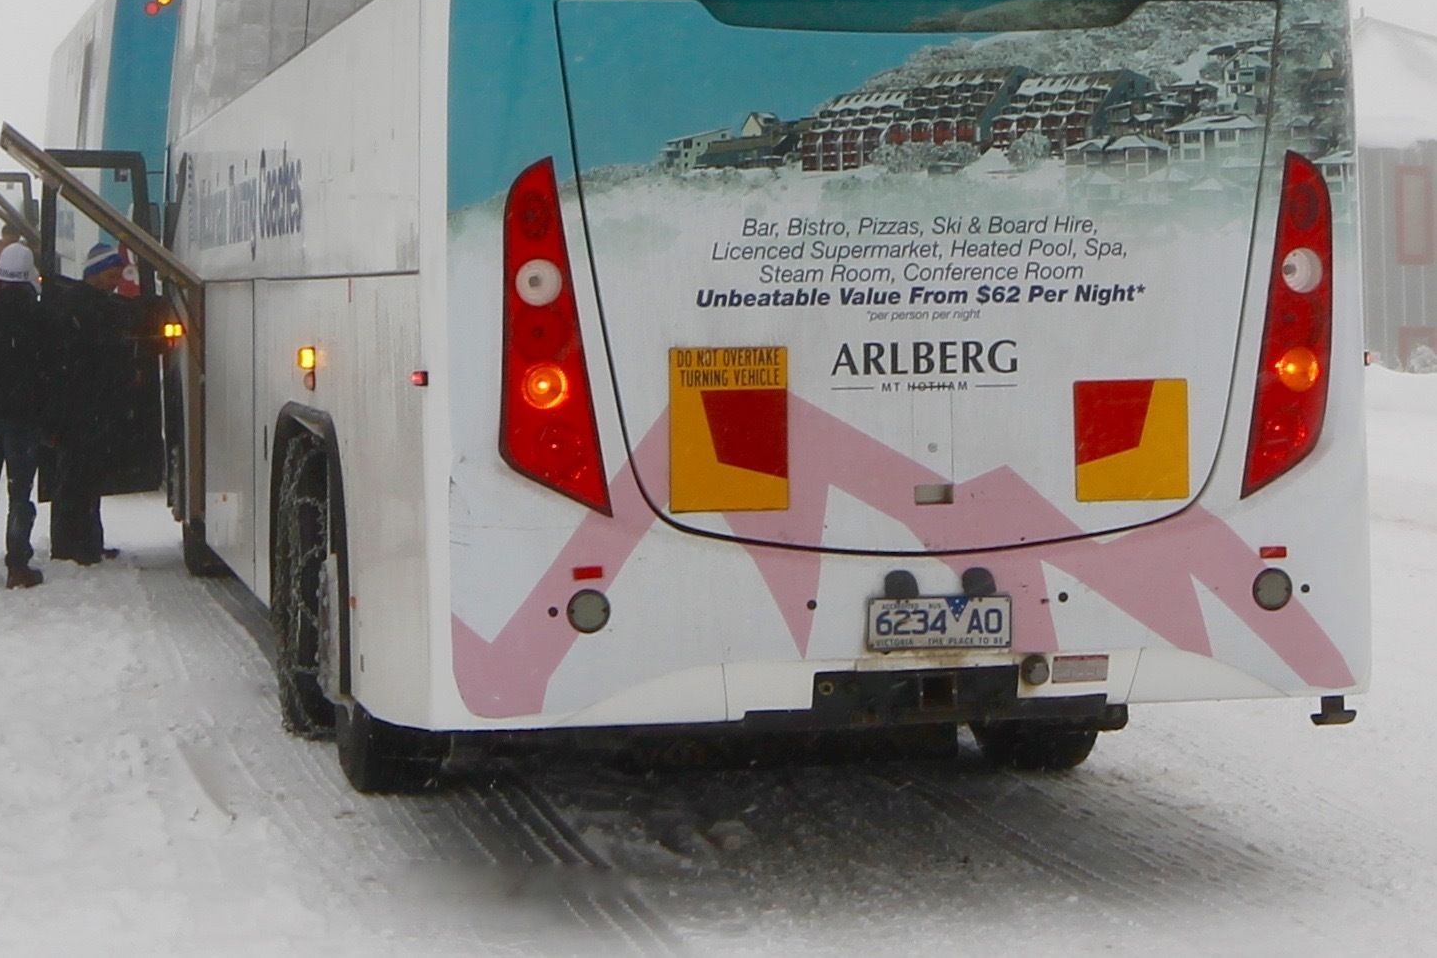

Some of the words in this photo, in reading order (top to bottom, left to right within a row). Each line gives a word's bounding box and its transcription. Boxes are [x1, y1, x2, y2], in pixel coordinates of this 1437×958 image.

[742, 218, 779, 238] Bar,
[787, 218, 850, 238] Bistro,
[858, 217, 924, 237] Pizzas,
[931, 216, 963, 235] Ski
[968, 216, 981, 234] &
[988, 216, 1049, 235] Board
[1054, 216, 1098, 236] Hire,
[712, 242, 805, 261] Licenced
[810, 240, 943, 262] Supermarket,
[950, 239, 1022, 258] Heated
[1028, 239, 1076, 259] Pool,
[1084, 238, 1127, 260] Spa,
[759, 264, 823, 283] Steam
[830, 264, 895, 284] Room,
[904, 262, 1019, 282] Conference
[1024, 261, 1084, 281] Room
[696, 289, 831, 308] Unbeatable
[839, 287, 901, 306] Value
[909, 286, 968, 304] From
[976, 284, 1021, 306] $62
[1028, 285, 1068, 304] Per
[890, 310, 929, 322] person
[931, 311, 952, 322] per
[952, 309, 981, 322] night
[677, 350, 692, 368] DO
[696, 349, 718, 367] NOT
[723, 348, 780, 367] OVERTAKE
[831, 339, 1019, 377] ARLBERG
[681, 370, 729, 387] TURNING
[733, 368, 780, 386] VEHICLE
[881, 382, 900, 392] MT
[908, 380, 968, 392] HOTHAM
[875, 608, 947, 636] 6234
